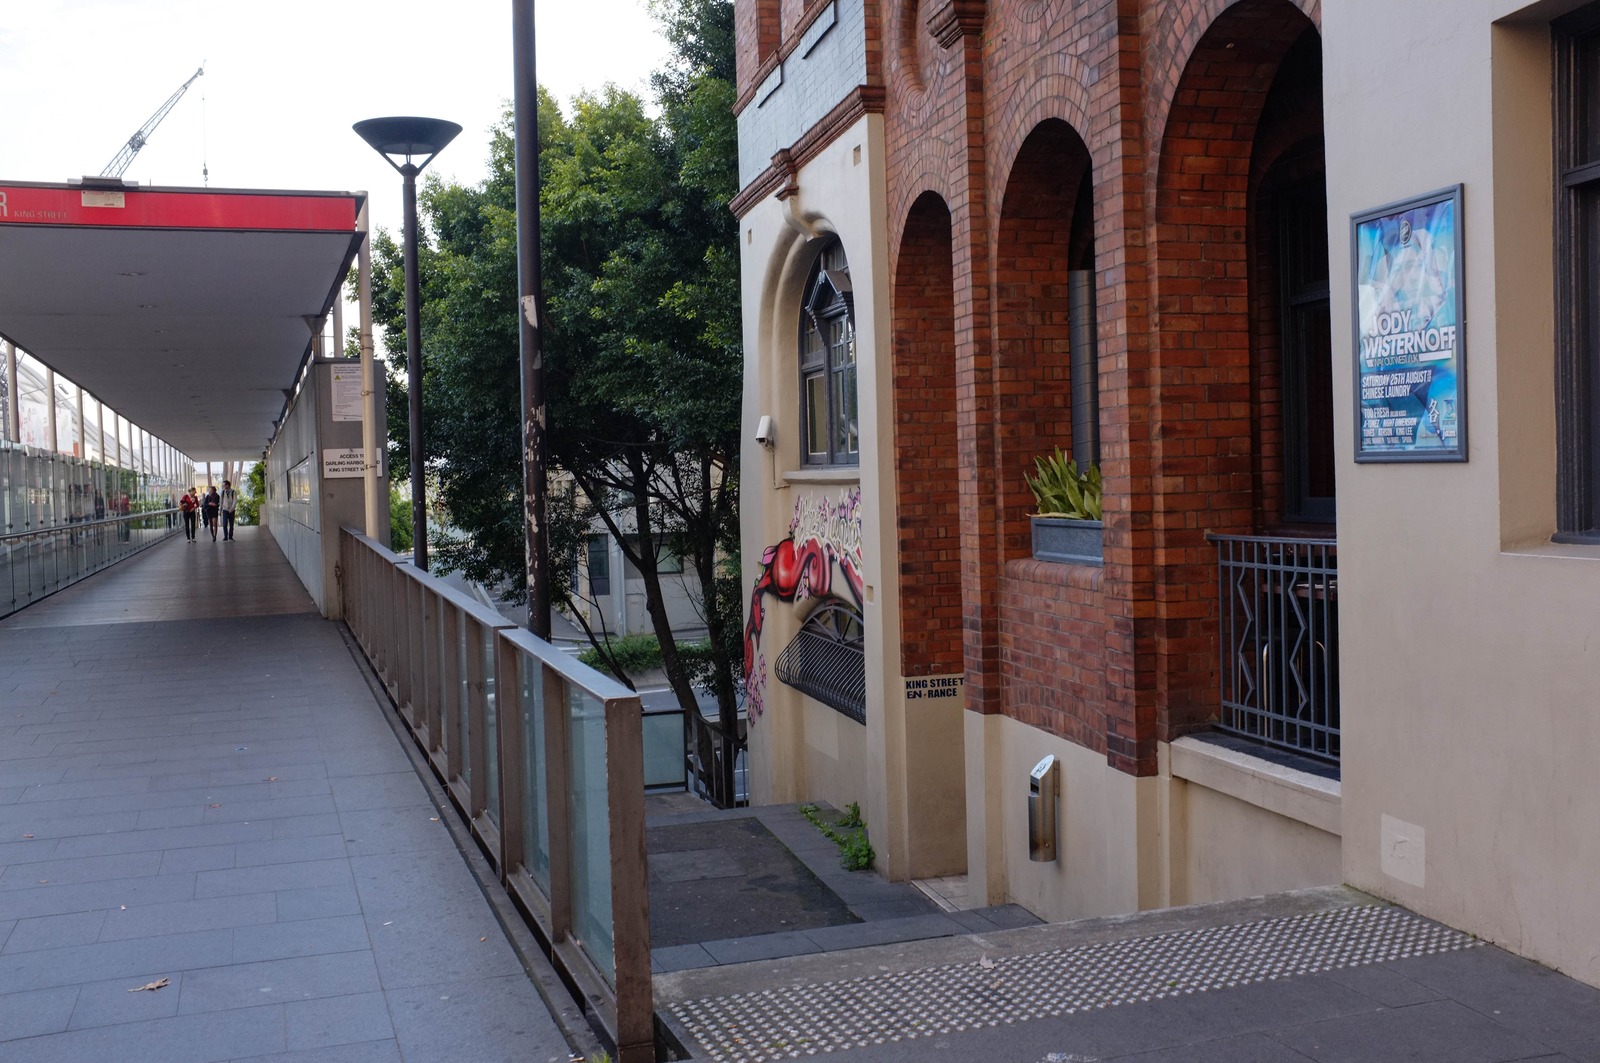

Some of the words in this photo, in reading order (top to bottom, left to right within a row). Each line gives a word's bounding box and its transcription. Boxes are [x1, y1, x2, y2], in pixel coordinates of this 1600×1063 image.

[14, 210, 35, 218] KING
[37, 211, 67, 219] STREET
[1369, 310, 1411, 337] JODY
[1363, 326, 1456, 359] WISTERNOFF
[1362, 374, 1390, 388] SATURDAY
[1390, 372, 1406, 385] 25TH
[1405, 370, 1428, 384] AUGUST
[1362, 387, 1385, 400] CHINESE
[1385, 384, 1411, 398] LAUNDRY
[1374, 407, 1390, 418] FRESH
[905, 680, 928, 690] KING
[930, 677, 964, 688] STREET
[906, 688, 957, 699] ENRANCE
